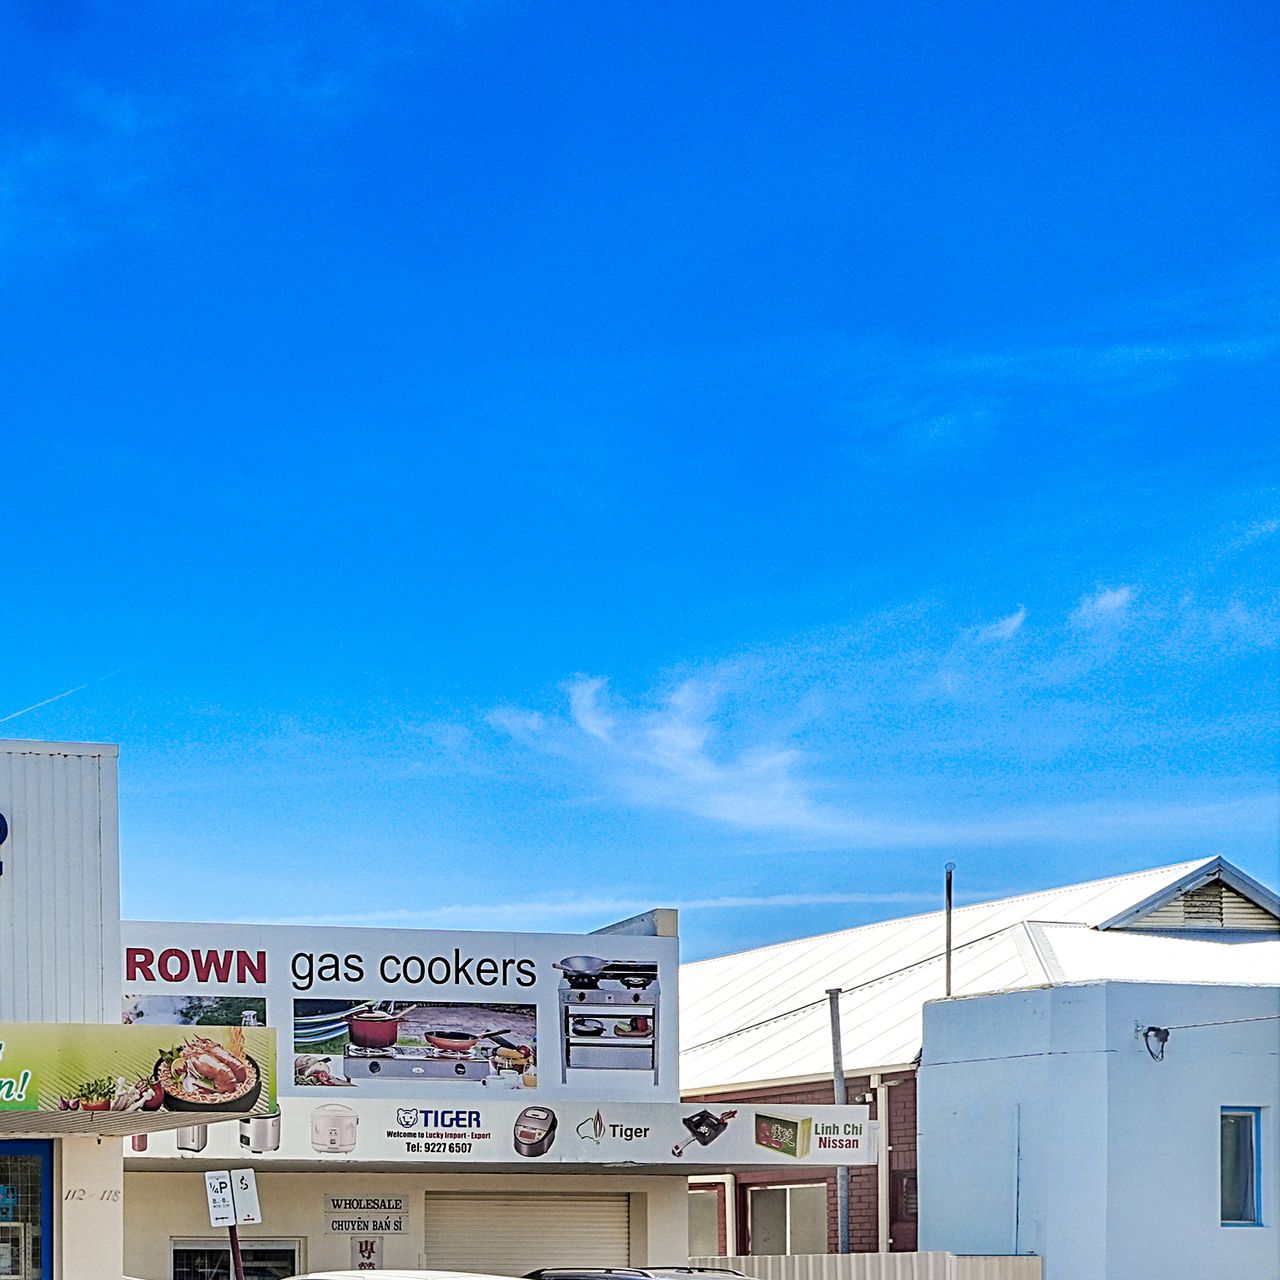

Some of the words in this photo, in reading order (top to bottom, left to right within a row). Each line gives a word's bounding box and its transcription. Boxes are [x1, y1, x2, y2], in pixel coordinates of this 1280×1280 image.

[291, 950, 364, 991] gas
[379, 948, 538, 987] cookers
[419, 1109, 481, 1128] TIGER
[471, 1132, 491, 1140] Export
[608, 1124, 650, 1141] Tiger
[814, 1123, 839, 1136] Linh
[843, 1123, 863, 1136] Chi
[406, 1141, 422, 1153] Tel:
[424, 1142, 447, 1153] 9227
[448, 1142, 472, 1153] 6507
[818, 1136, 859, 1149] Nissan
[64, 1188, 86, 1201] 112
[331, 1199, 402, 1209] WHOLESALE
